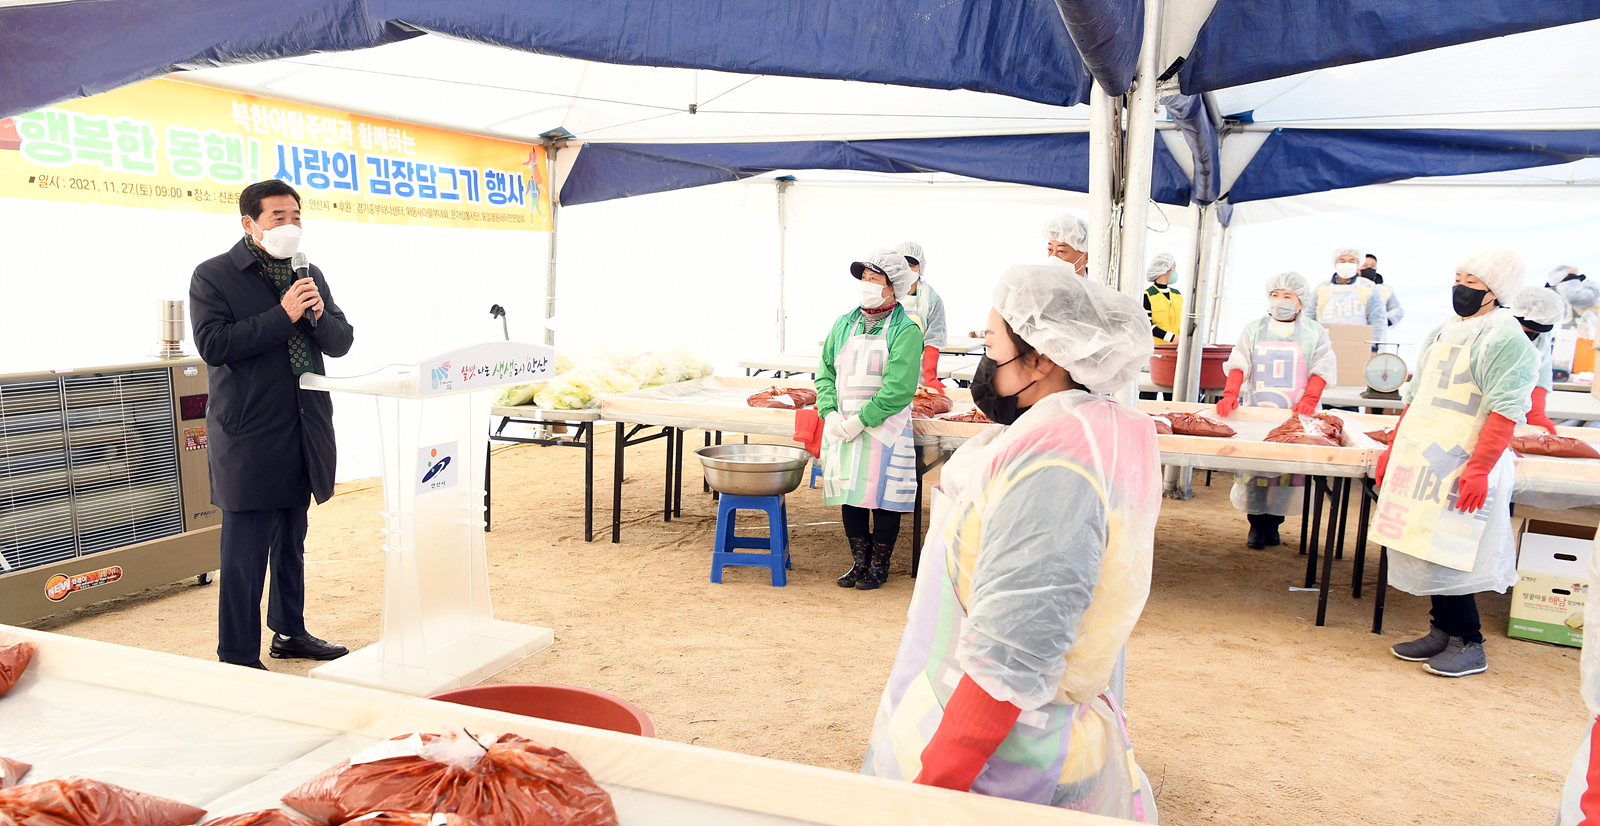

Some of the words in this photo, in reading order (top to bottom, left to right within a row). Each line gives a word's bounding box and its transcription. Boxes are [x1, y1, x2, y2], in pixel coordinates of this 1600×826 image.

[231, 100, 354, 147] 북한이탈주민과
[356, 121, 417, 155] 함께하는
[17, 110, 156, 173] 행복한
[167, 127, 261, 183] 동행!
[273, 143, 359, 192] 사랑의
[366, 155, 480, 202] 김장담그기
[484, 169, 525, 205] 행사
[38, 174, 59, 189] 일시
[69, 177, 100, 192] 2021.
[103, 181, 120, 194] 11.
[121, 182, 153, 198] 27.(토)
[155, 186, 183, 199] 09:00
[194, 188, 212, 202] 장소
[309, 198, 330, 211] 안산시
[338, 200, 352, 213] 후원
[526, 356, 548, 374] 안산
[430, 480, 446, 489] 안산시
[48, 578, 71, 597] NEW
[1548, 595, 1567, 608] 해남
